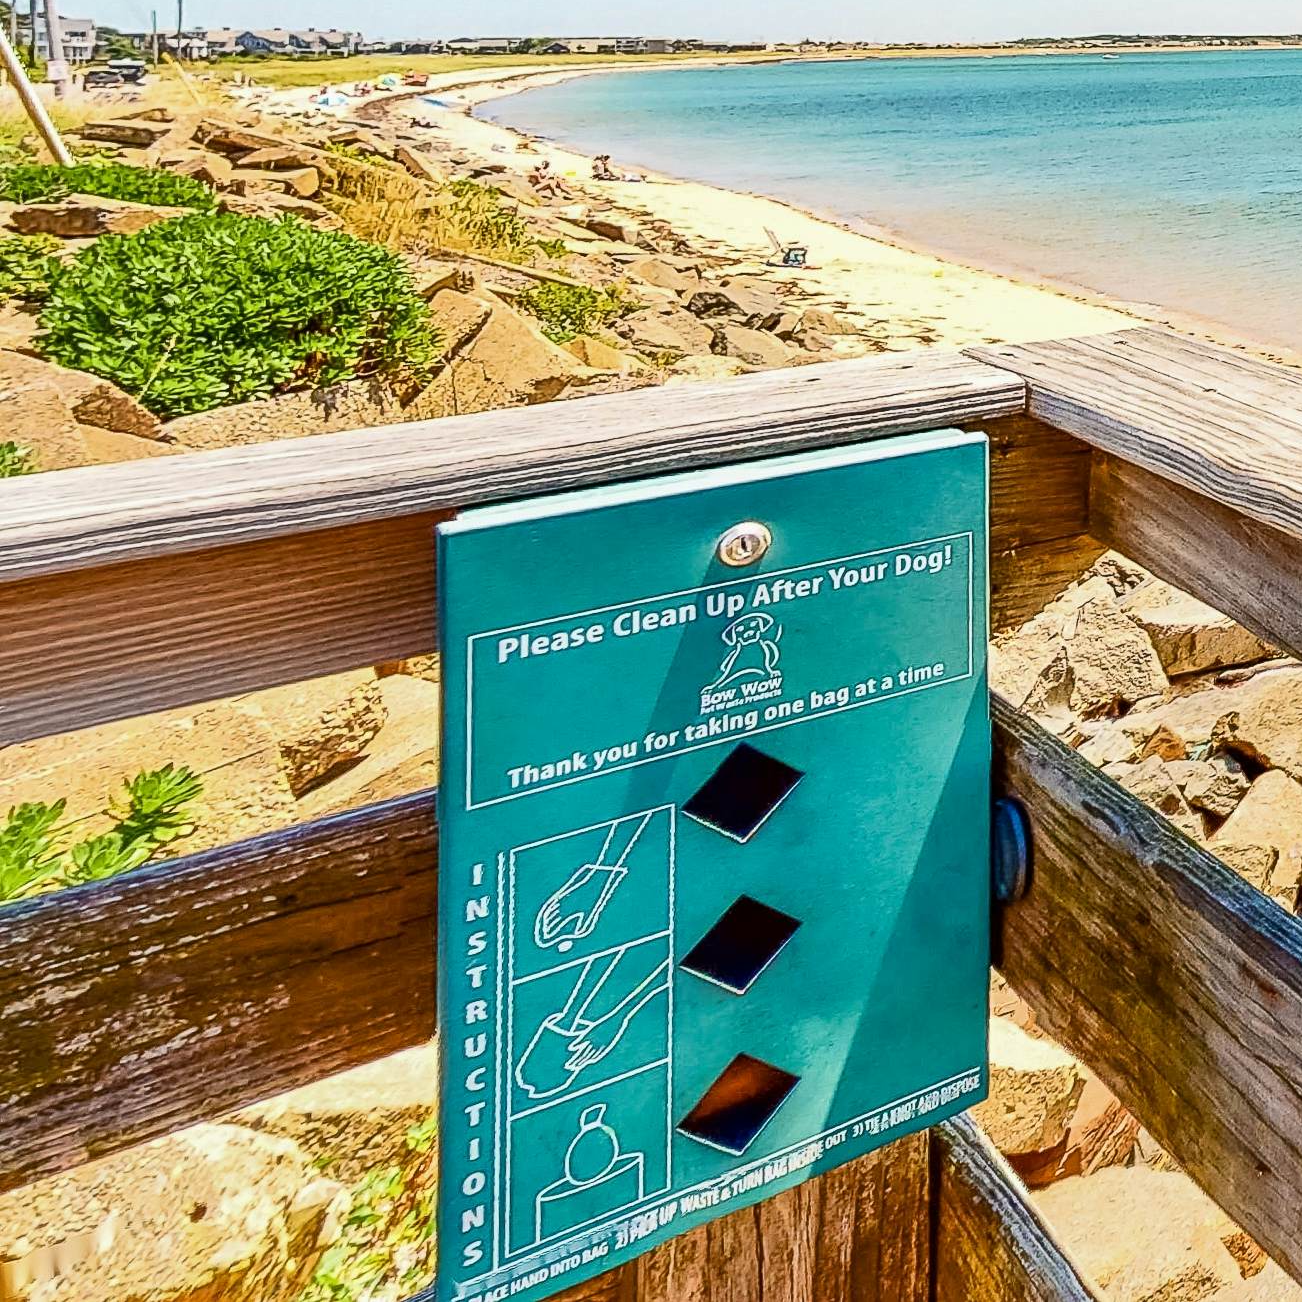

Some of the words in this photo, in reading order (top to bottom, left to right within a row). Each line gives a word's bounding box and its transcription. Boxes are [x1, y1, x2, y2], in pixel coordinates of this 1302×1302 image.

[498, 624, 605, 664] Please
[613, 604, 697, 637] Clean
[706, 593, 745, 618] Up
[752, 576, 824, 607] After
[828, 562, 889, 590] Your
[895, 545, 952, 576] Dog!
[507, 752, 588, 789] Thank
[593, 741, 638, 771] you
[643, 731, 680, 752] for
[684, 711, 758, 742] taking
[764, 699, 805, 721] one
[810, 686, 851, 710] bag
[855, 678, 877, 698] at
[880, 677, 894, 691] a
[899, 662, 945, 687] time
[701, 688, 737, 708] Bow
[741, 677, 783, 697] Wow
[462, 863, 490, 1267] INSTRUCTIONS
[468, 1283, 510, 1302] ACE
[511, 1267, 550, 1296] HAND
[550, 1254, 581, 1279] INTO
[581, 1242, 609, 1265] BAG
[659, 1200, 678, 1226] UP
[680, 1187, 721, 1215] WASTE
[720, 1185, 733, 1200] &
[731, 1170, 763, 1197] TURN
[852, 1122, 864, 1138] 3)
